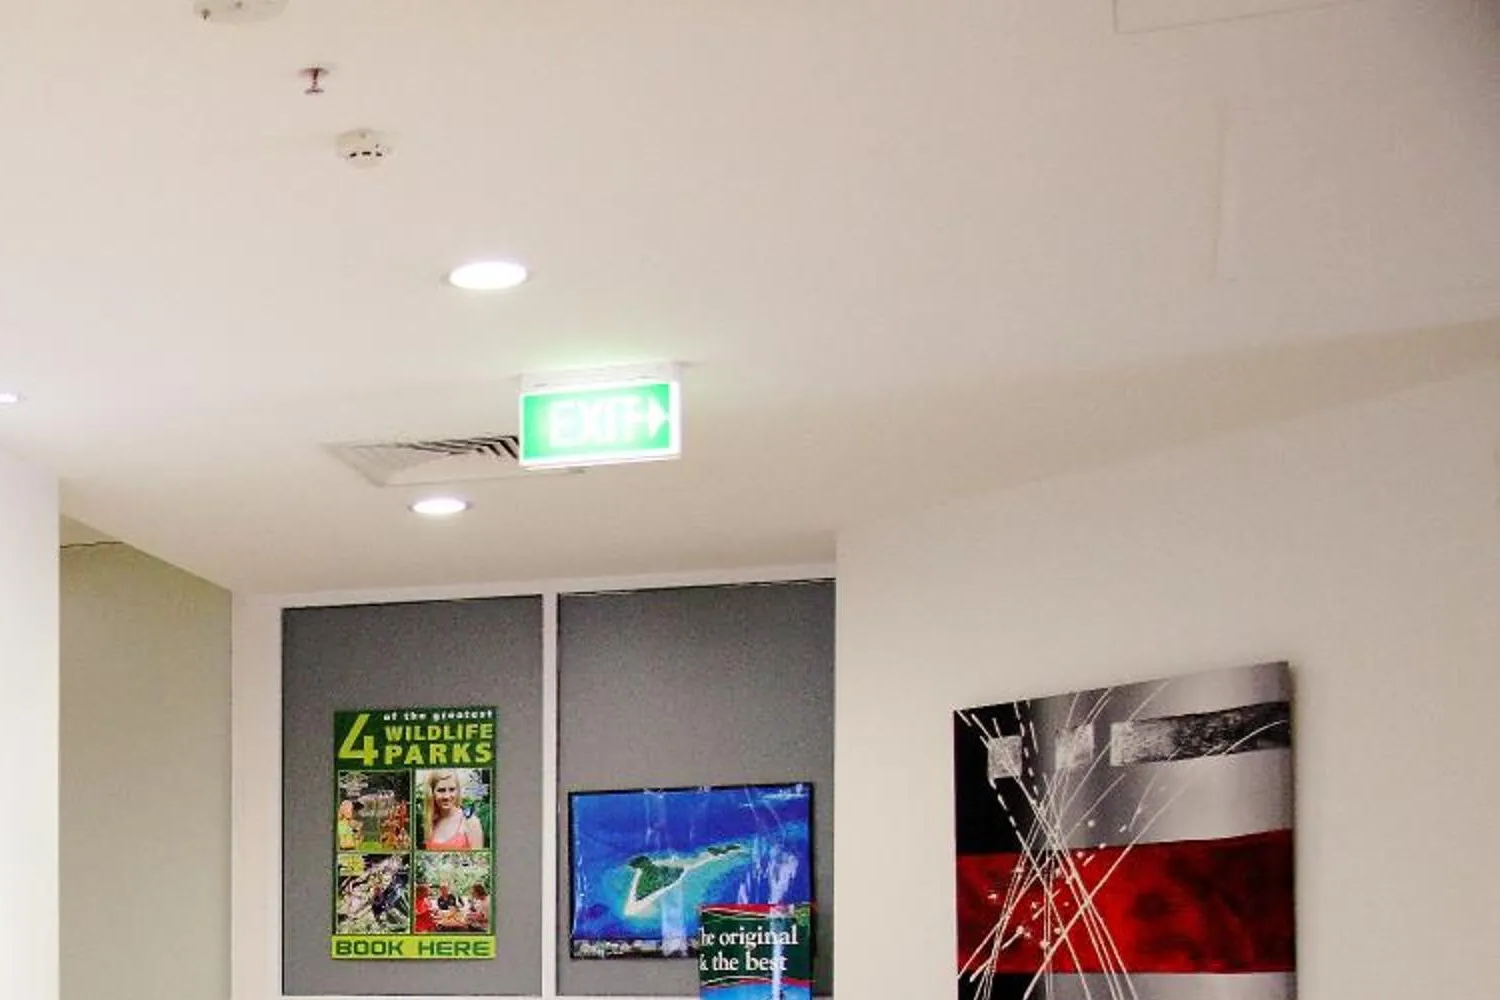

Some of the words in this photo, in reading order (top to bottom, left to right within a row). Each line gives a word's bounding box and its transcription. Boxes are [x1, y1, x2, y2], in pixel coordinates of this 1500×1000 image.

[548, 394, 642, 447] EXIT
[404, 711, 426, 721] the
[433, 710, 493, 722] greatest
[338, 713, 378, 767] 4
[384, 723, 493, 741] WILDLIFE
[384, 742, 493, 766] PARKS
[335, 940, 404, 956] BOOK
[417, 941, 491, 956] HERE
[720, 924, 799, 950] original
[712, 950, 739, 971] the
[745, 949, 788, 971] best
